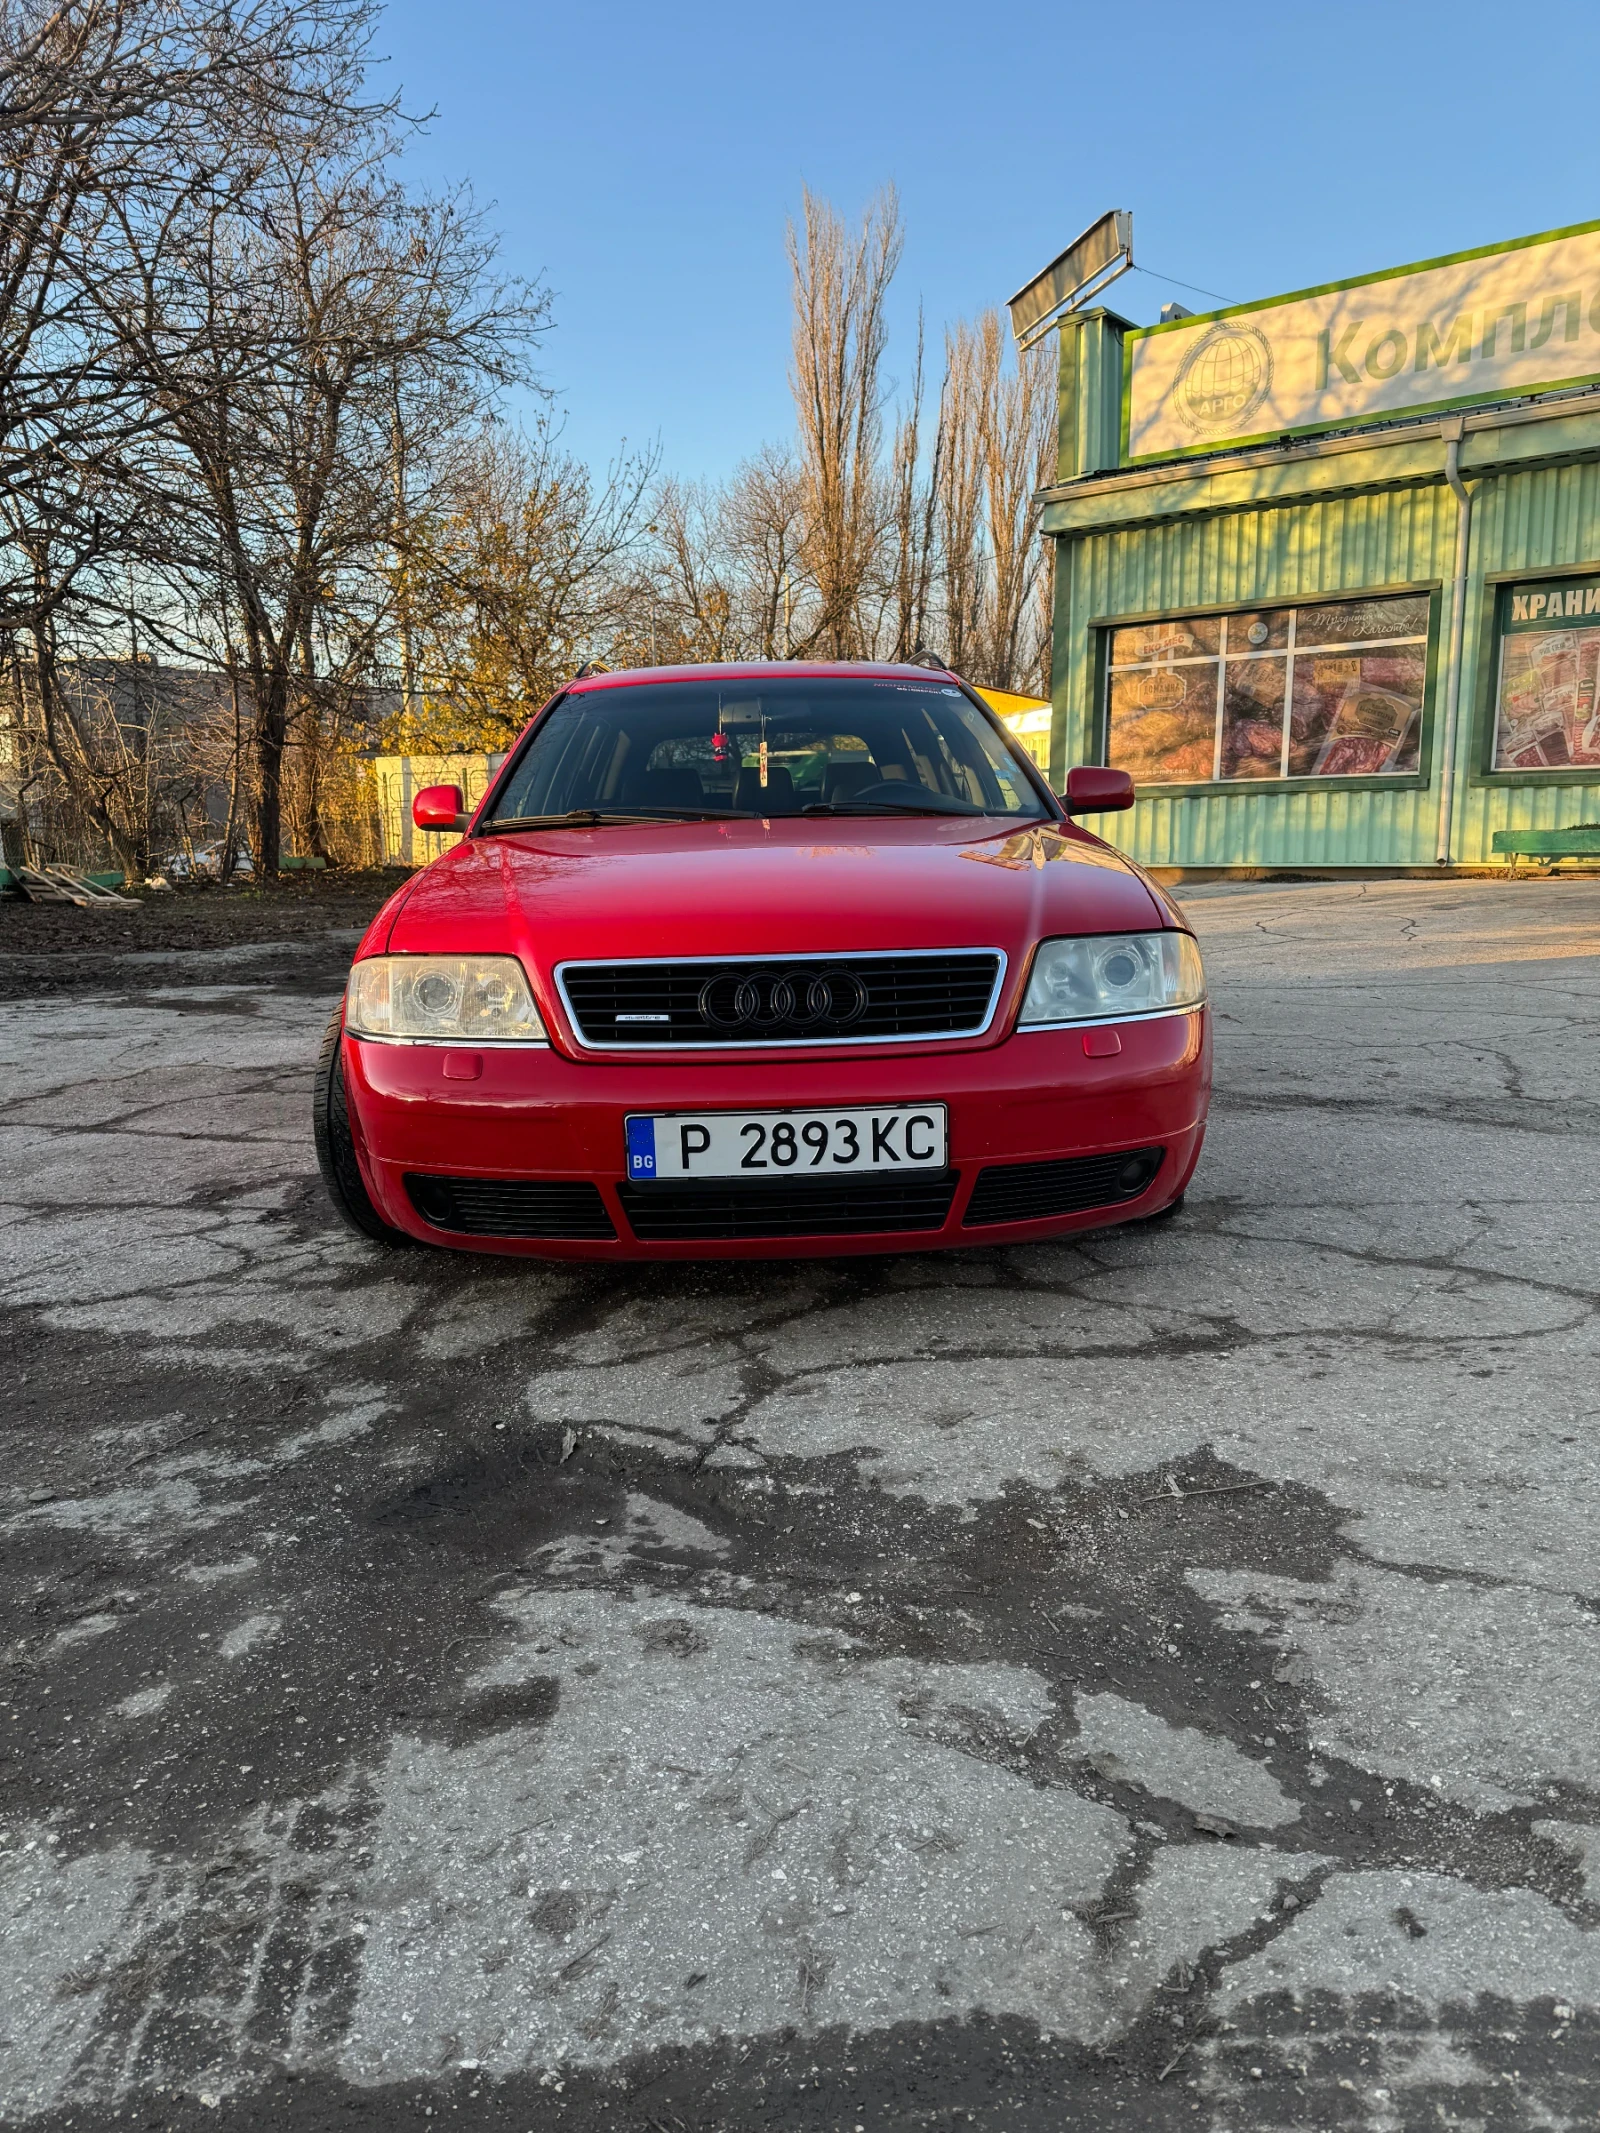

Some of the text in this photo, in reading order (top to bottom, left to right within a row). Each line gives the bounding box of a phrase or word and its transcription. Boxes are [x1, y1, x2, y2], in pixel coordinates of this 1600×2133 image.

[1315, 286, 1600, 391] Компл
[1199, 394, 1246, 415] АРГО
[1143, 635, 1185, 654] ЕКО МЕС
[680, 1115, 936, 1169] P 2893 KC
[632, 1155, 654, 1169] BG
